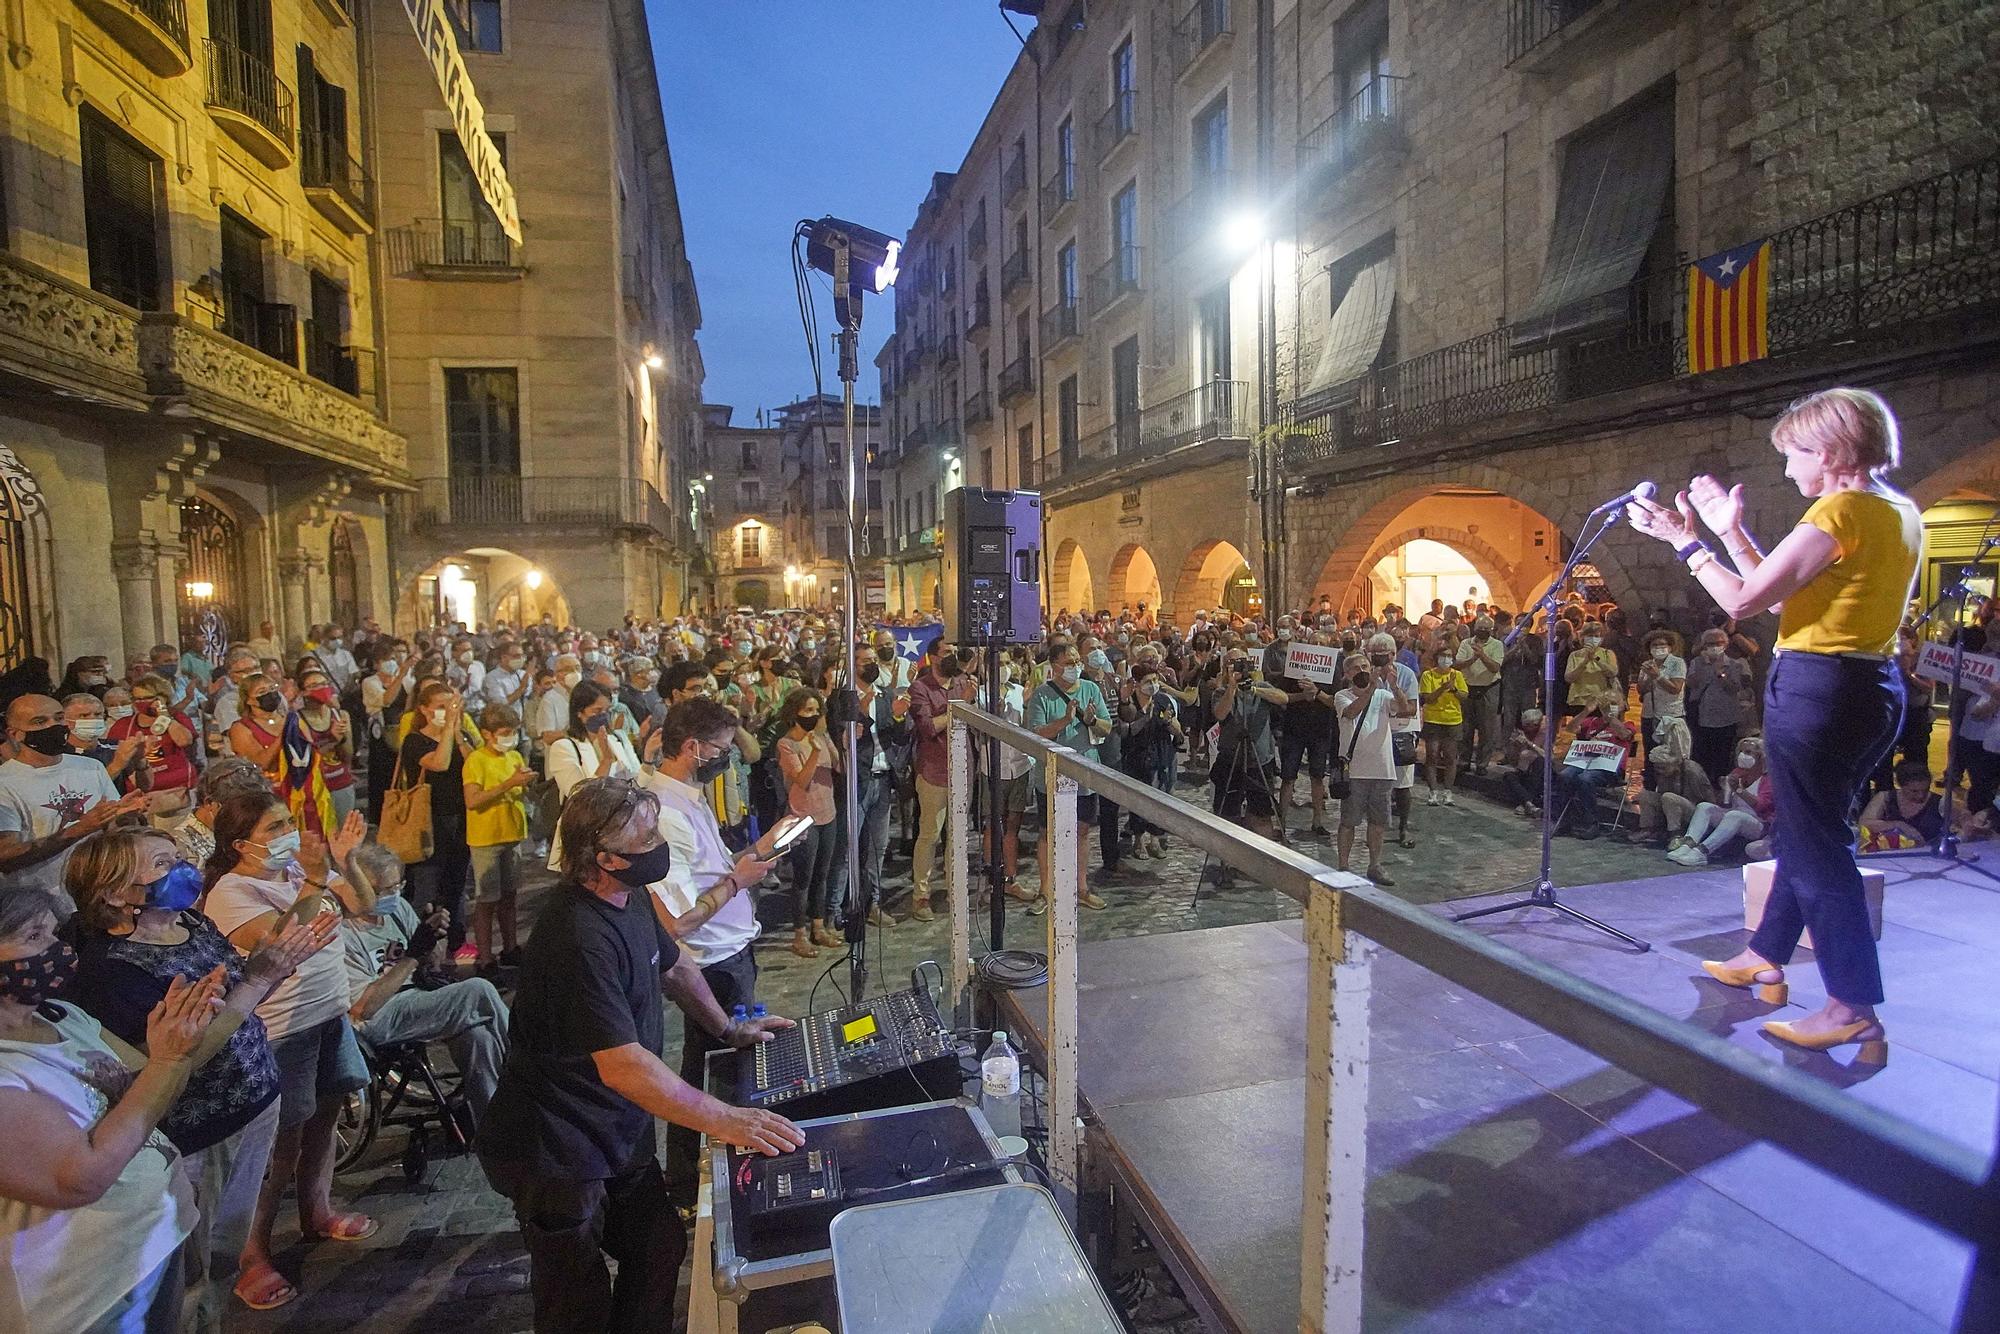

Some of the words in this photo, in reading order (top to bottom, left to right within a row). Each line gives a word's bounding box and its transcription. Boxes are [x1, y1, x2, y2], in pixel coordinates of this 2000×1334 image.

[1290, 650, 1333, 667] AMNISTIA
[1926, 648, 1994, 678] AMNSTIA
[1288, 661, 1311, 672] FEM-NOS
[1574, 743, 1618, 756] AMNISTIA
